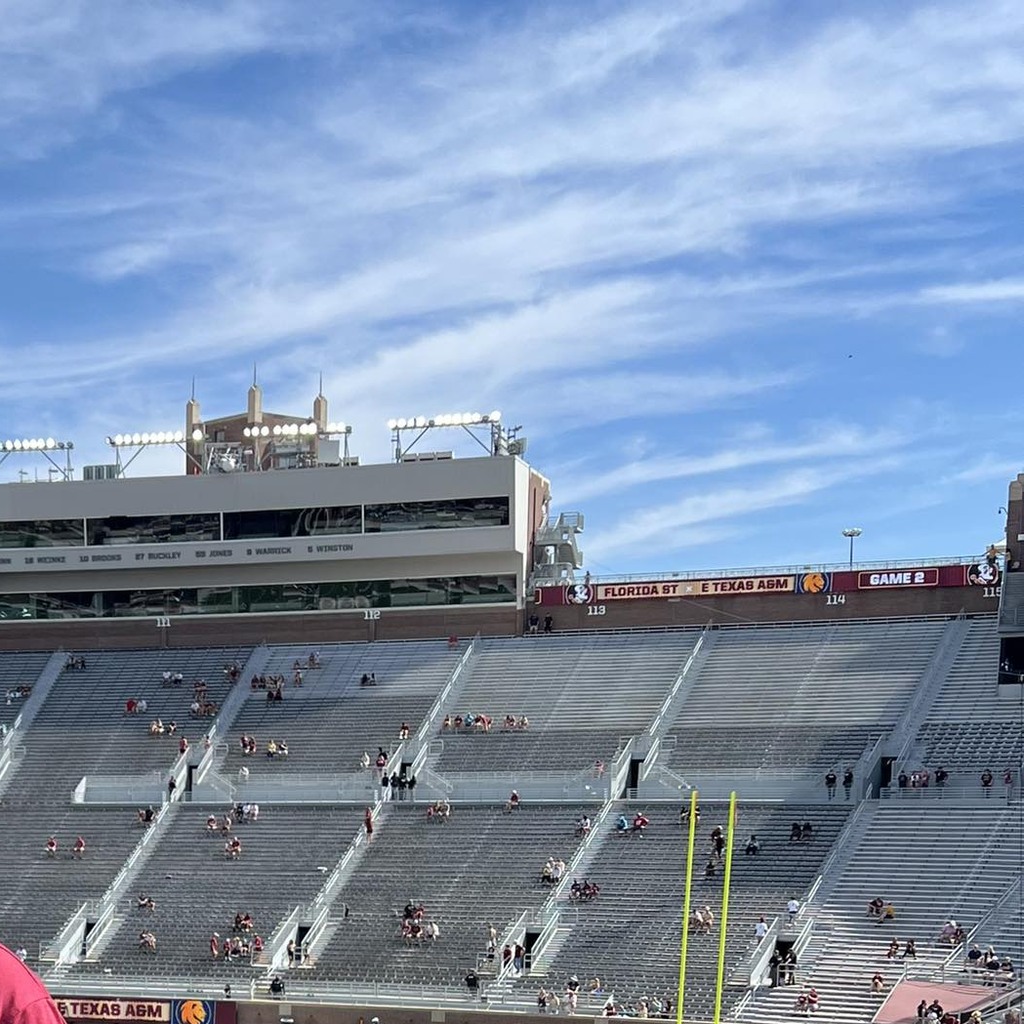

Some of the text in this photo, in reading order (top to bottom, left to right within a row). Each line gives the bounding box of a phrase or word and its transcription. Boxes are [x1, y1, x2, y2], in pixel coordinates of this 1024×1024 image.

[255, 547, 292, 555] WARRICK
[316, 544, 354, 553] WINSTON
[869, 572, 925, 586] GAME 2
[604, 584, 679, 597] FLORIDA ST
[701, 578, 788, 593] E TEXAS A&M
[825, 594, 846, 605] 114
[363, 610, 381, 620] 112
[587, 605, 606, 615] 113
[155, 618, 171, 627] 111
[70, 1002, 121, 1016] TEXAS
[125, 1004, 162, 1018] A&M
